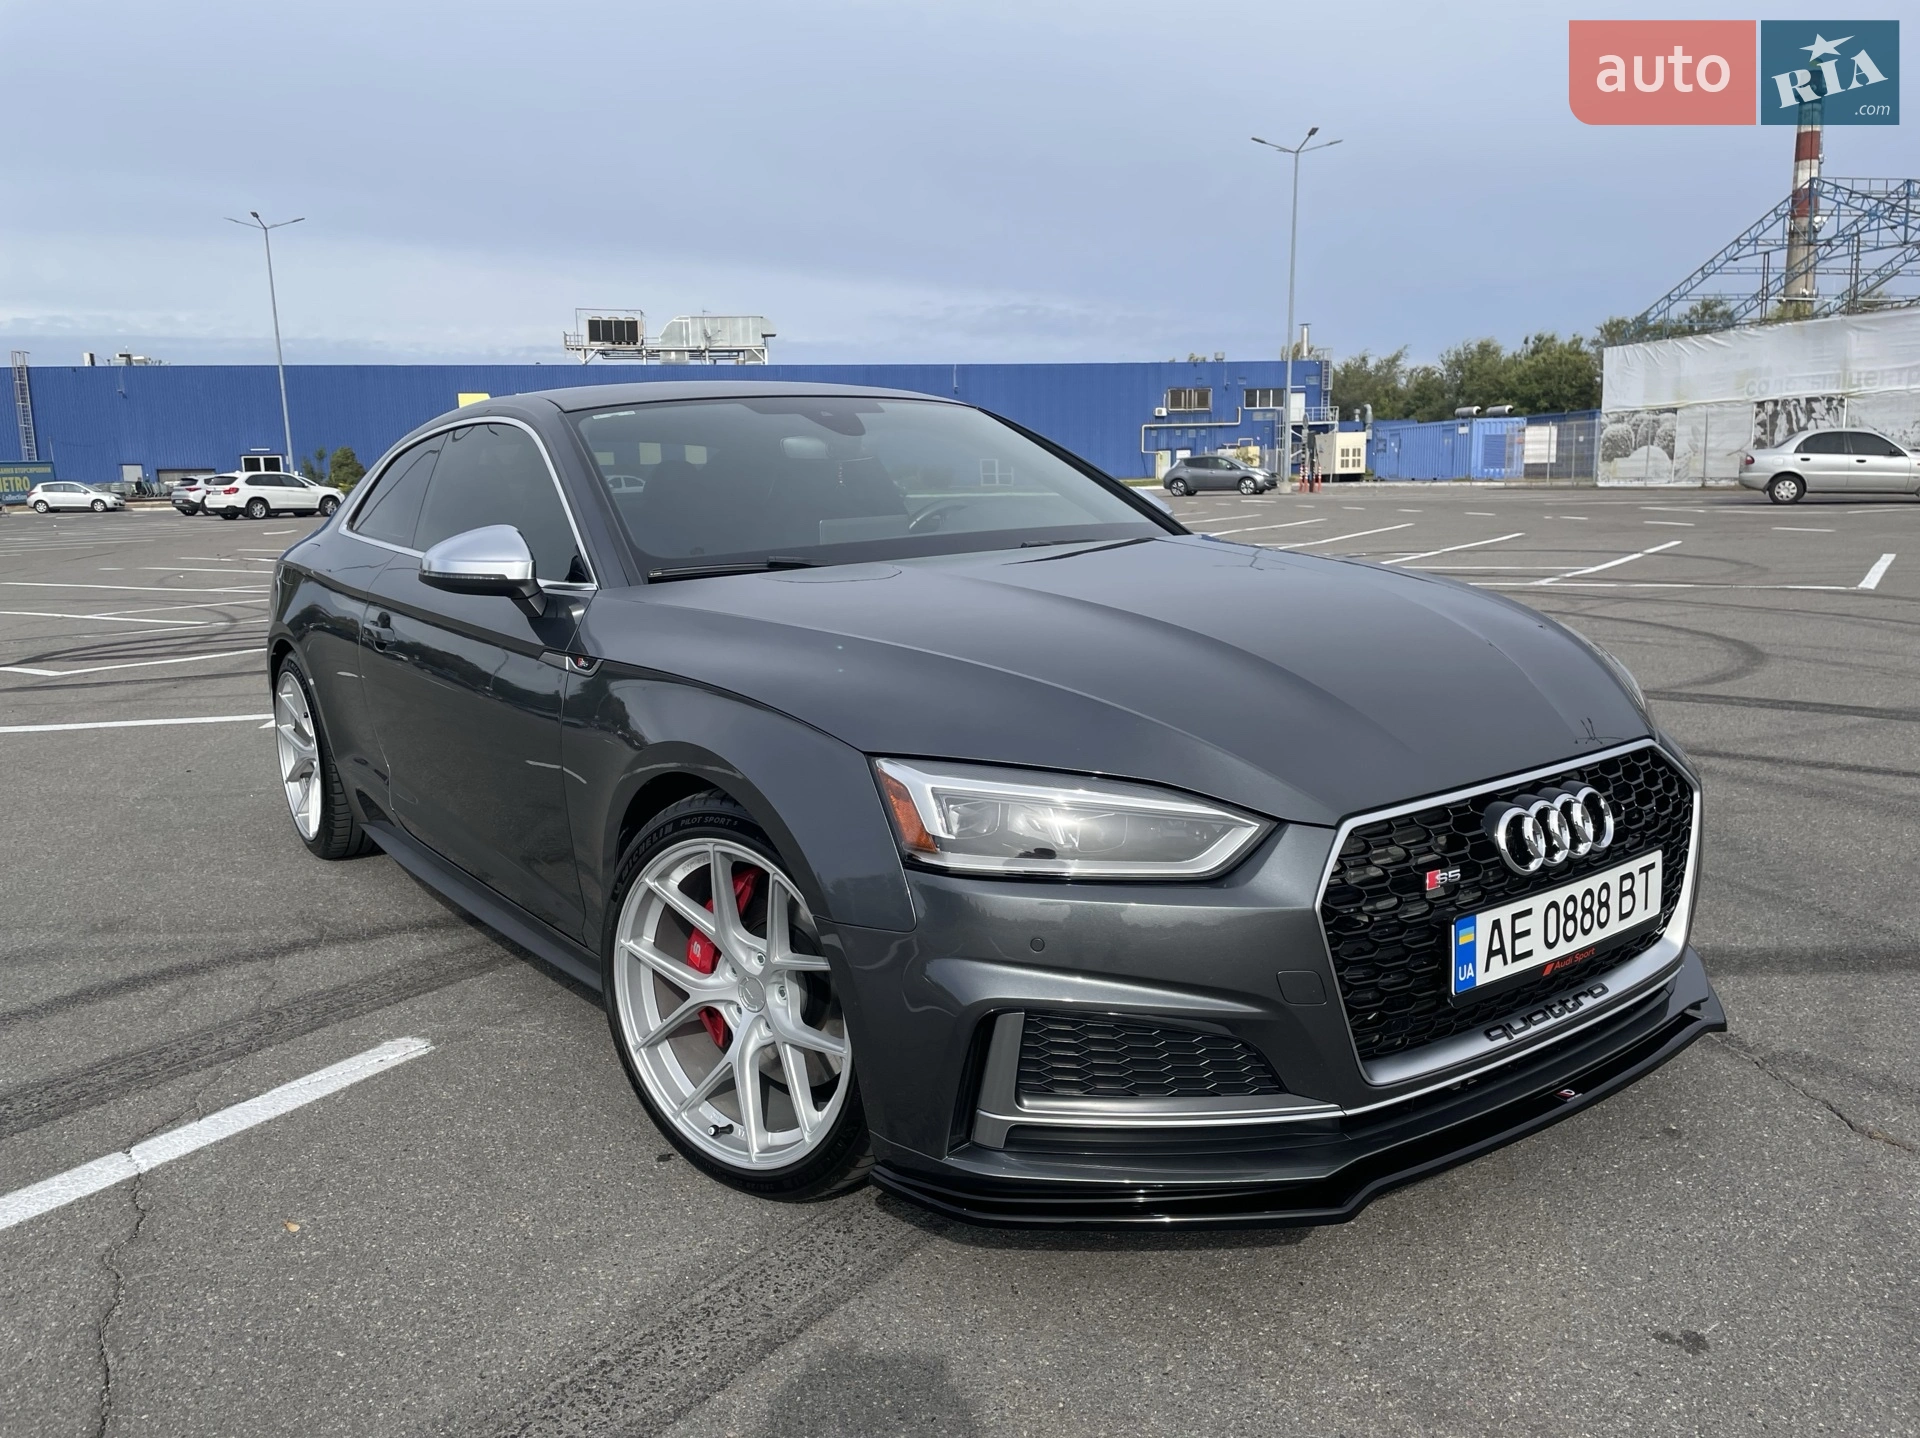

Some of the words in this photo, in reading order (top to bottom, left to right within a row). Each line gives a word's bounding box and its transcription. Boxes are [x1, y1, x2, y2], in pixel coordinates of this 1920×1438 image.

[622, 822, 674, 880] MICHELIN
[680, 816, 702, 827] PILOT
[704, 816, 732, 826] SPORT
[1436, 869, 1461, 884] S5
[1484, 908, 1533, 973] AE
[1544, 882, 1611, 950] 0888
[1618, 862, 1656, 921] BT
[1458, 962, 1475, 981] UA
[1554, 956, 1574, 970] Audi
[1574, 947, 1596, 962] Sport
[1483, 982, 1610, 1042] quattro
